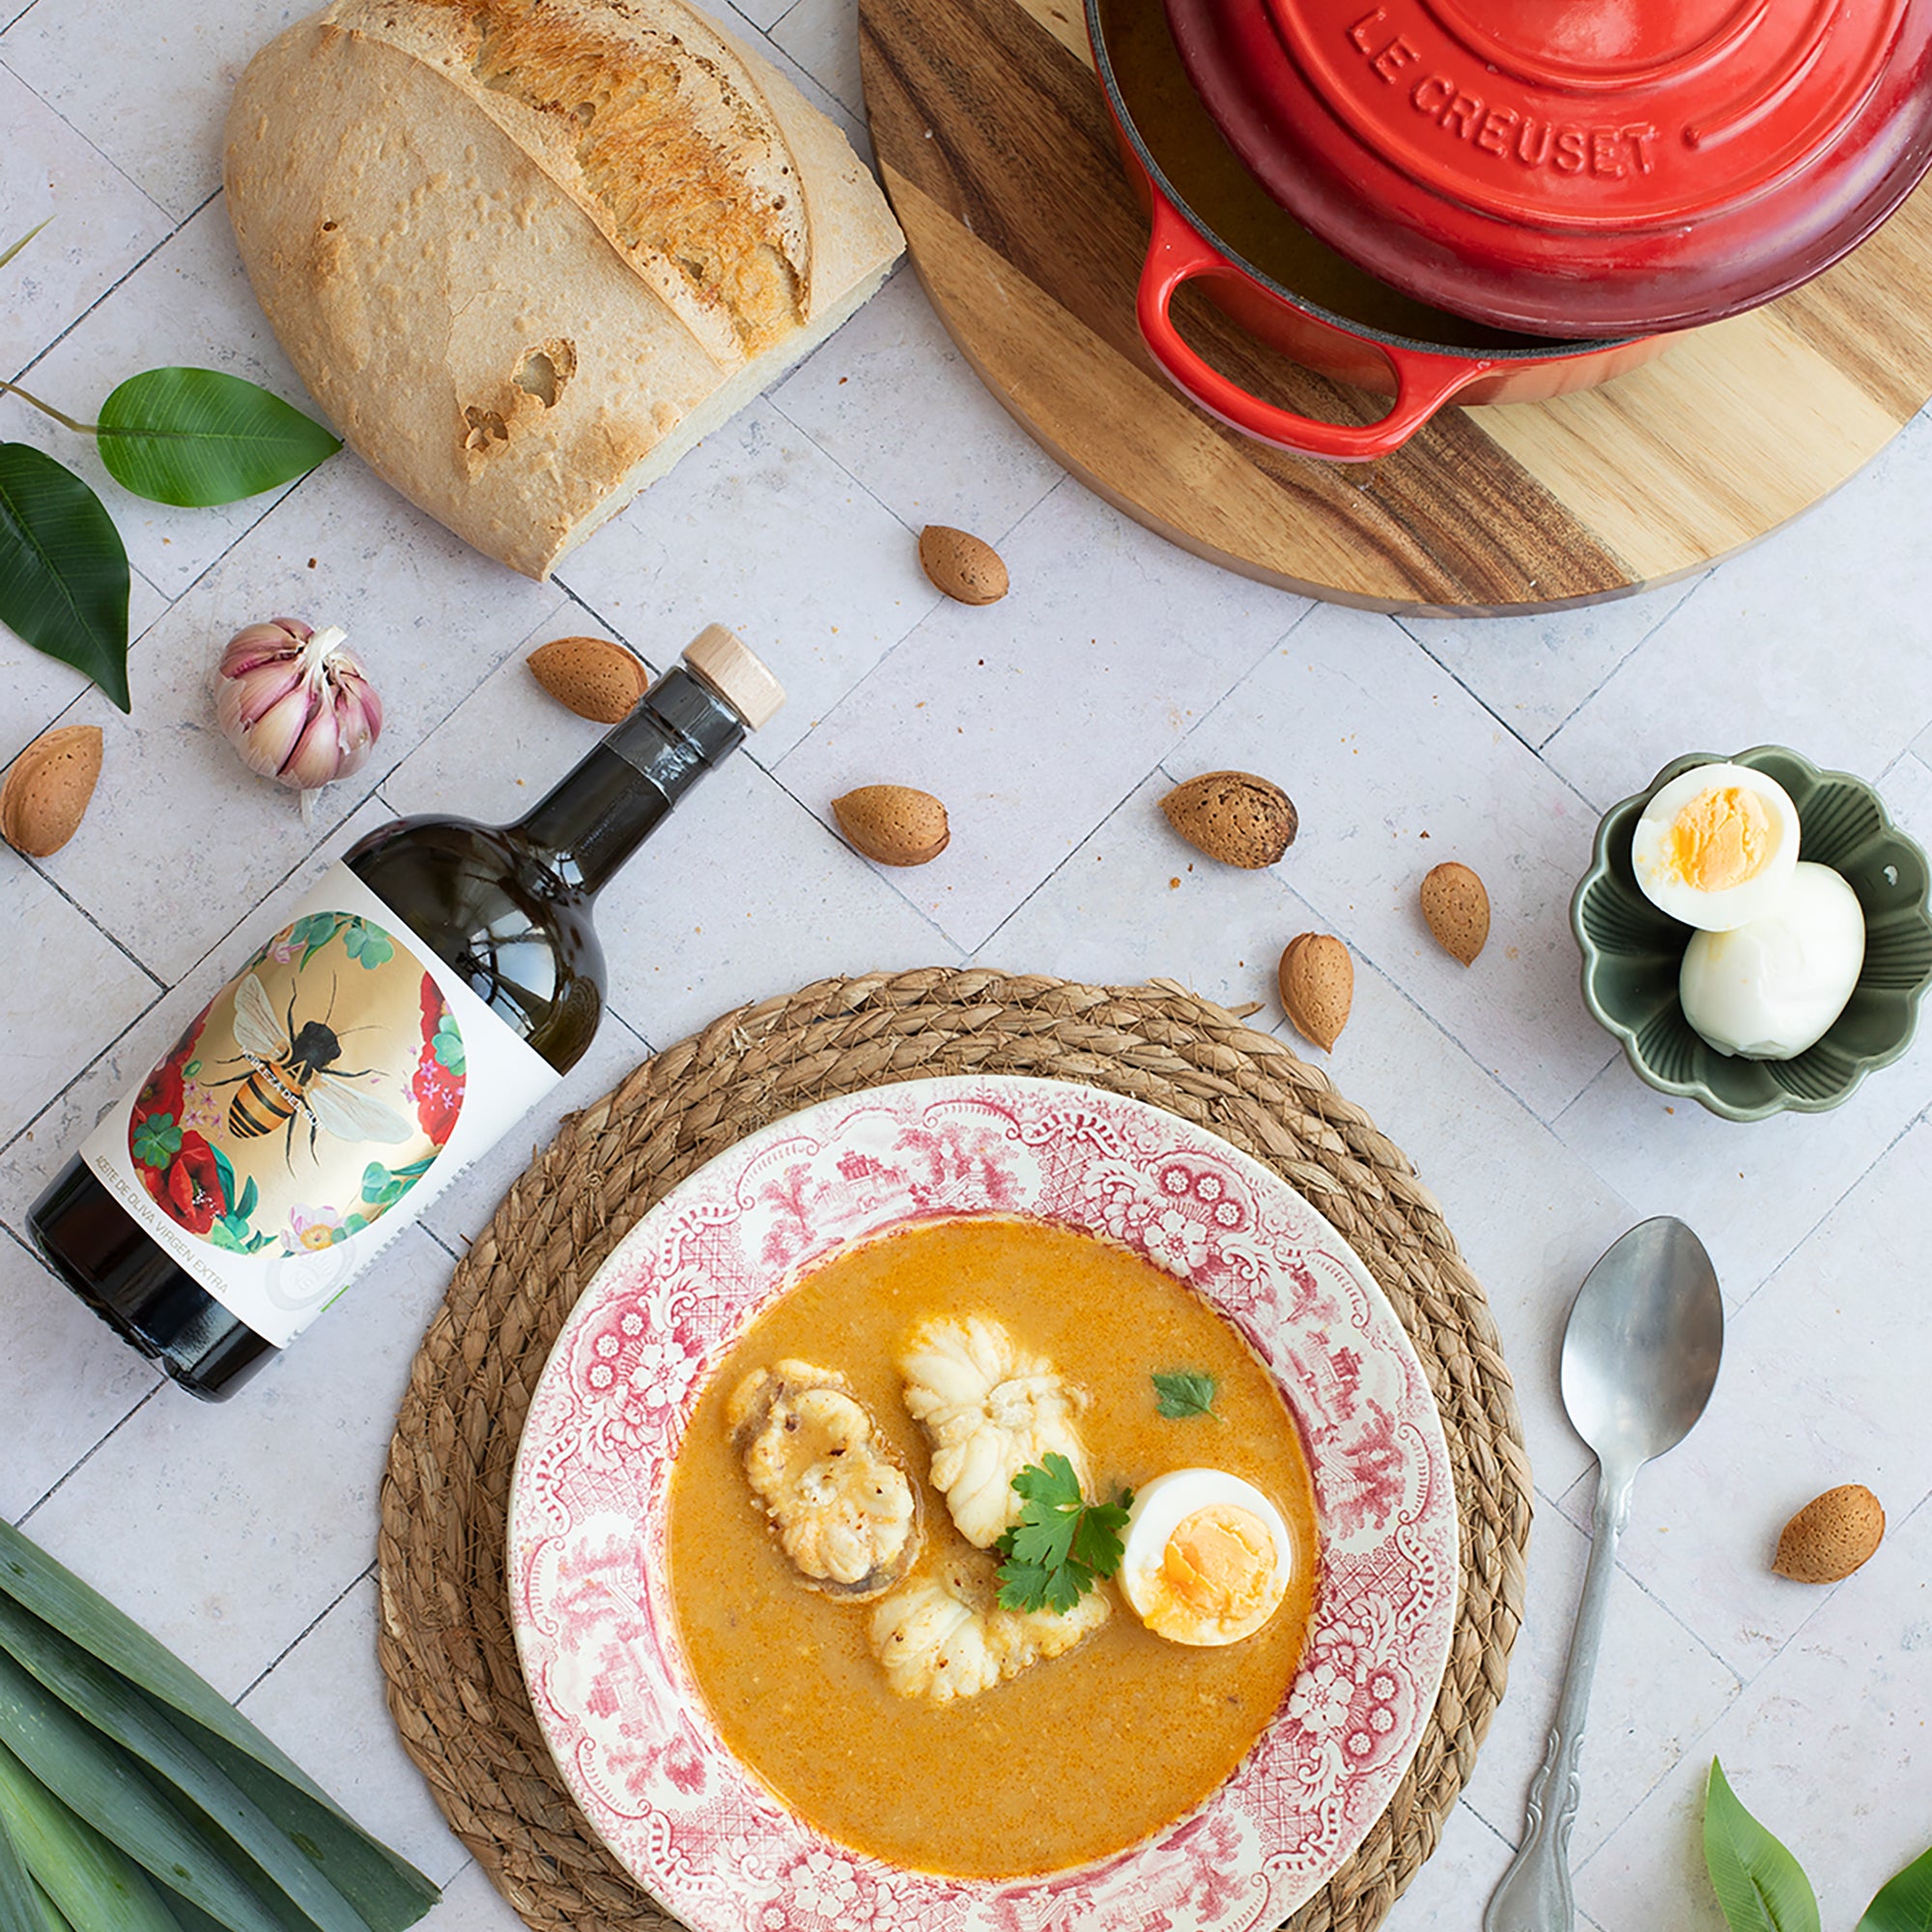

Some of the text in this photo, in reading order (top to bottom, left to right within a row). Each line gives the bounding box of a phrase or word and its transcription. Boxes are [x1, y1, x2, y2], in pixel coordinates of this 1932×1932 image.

[1346, 7, 1660, 178] LE CREUSET
[281, 1089, 301, 1113] DEL
[302, 1108, 326, 1132] SUR
[95, 1154, 229, 1294] ACEITE DE OLIVA VIRGEN EXTRA
